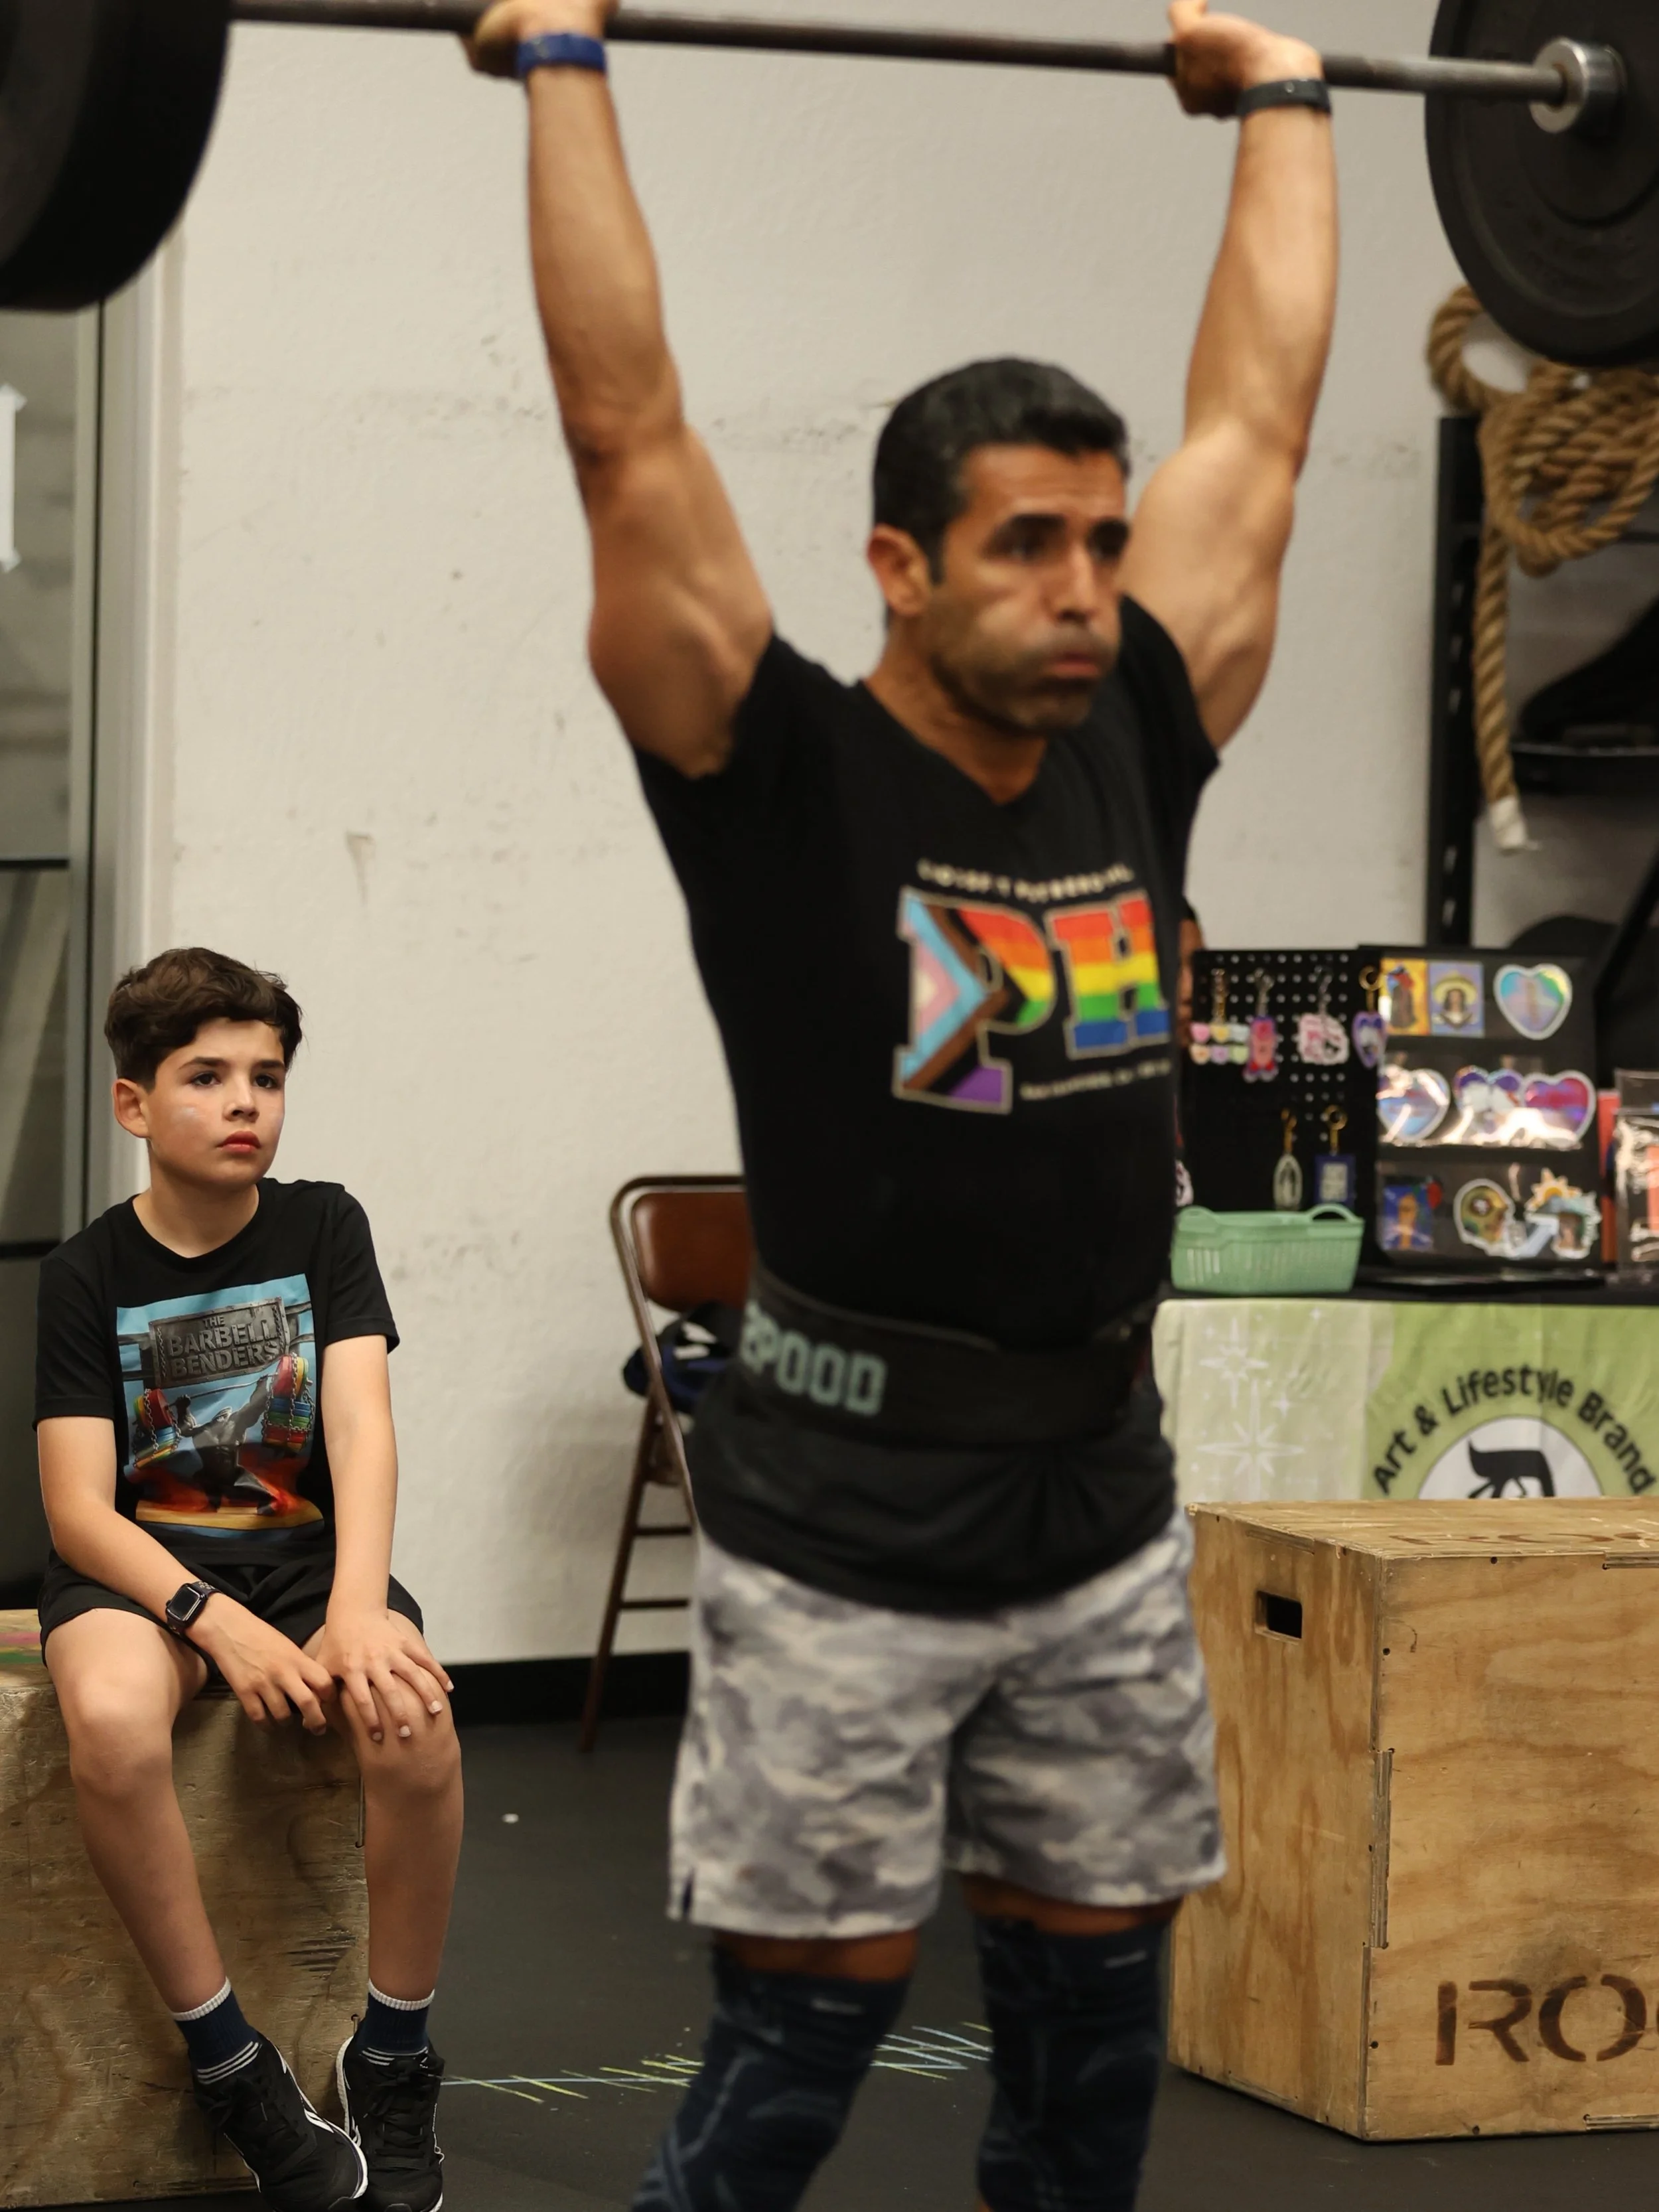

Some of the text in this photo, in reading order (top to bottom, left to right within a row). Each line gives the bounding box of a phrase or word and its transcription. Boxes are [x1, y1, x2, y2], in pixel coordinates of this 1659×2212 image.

[170, 1320, 278, 1357] BARBELL
[204, 1315, 225, 1327] THE
[171, 1341, 279, 1377] BENDERS
[1373, 1364, 1656, 1495] Art & Lifestyle Brand
[1435, 1974, 1659, 2066] RO
